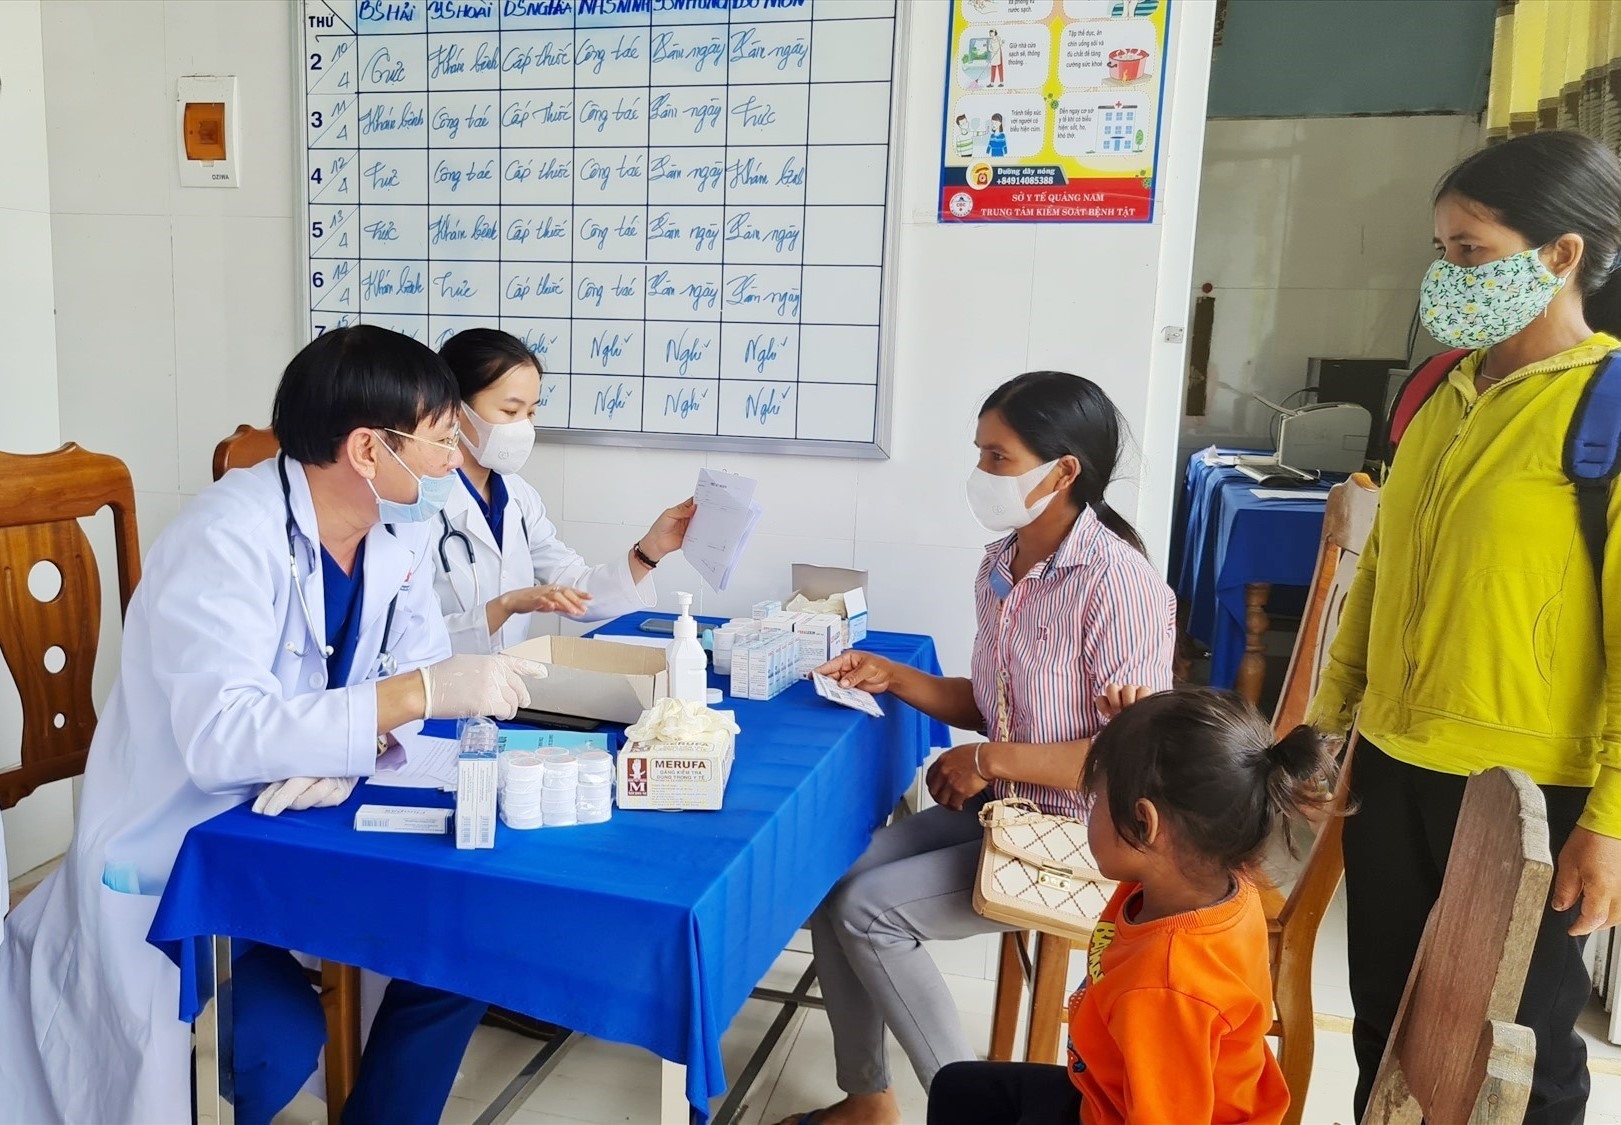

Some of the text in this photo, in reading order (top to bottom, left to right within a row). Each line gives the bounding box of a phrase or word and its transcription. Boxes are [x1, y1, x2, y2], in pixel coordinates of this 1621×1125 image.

[359, 0, 384, 20] BS
[308, 13, 336, 28] THỨ
[331, 43, 347, 62] 10
[310, 53, 322, 70] 2
[338, 71, 349, 88] 4
[311, 111, 323, 129] 3
[336, 124, 348, 141] 4
[330, 157, 348, 174] 12
[1037, 168, 1055, 176] nóng
[310, 168, 322, 184] 4
[338, 177, 349, 194] 4
[1012, 191, 1104, 203] SỞ Y TẾ QUẢNG NAM
[329, 209, 344, 229] 13
[981, 205, 1135, 217] TRUNG TÂM KIỂM SOÁT BỆNH TẬT
[312, 222, 323, 239] 5
[338, 232, 348, 248] 4
[312, 271, 324, 288] 6
[332, 261, 349, 281] 14
[339, 288, 350, 306] 4
[655, 760, 706, 769] MERUFA
[629, 781, 645, 792] M
